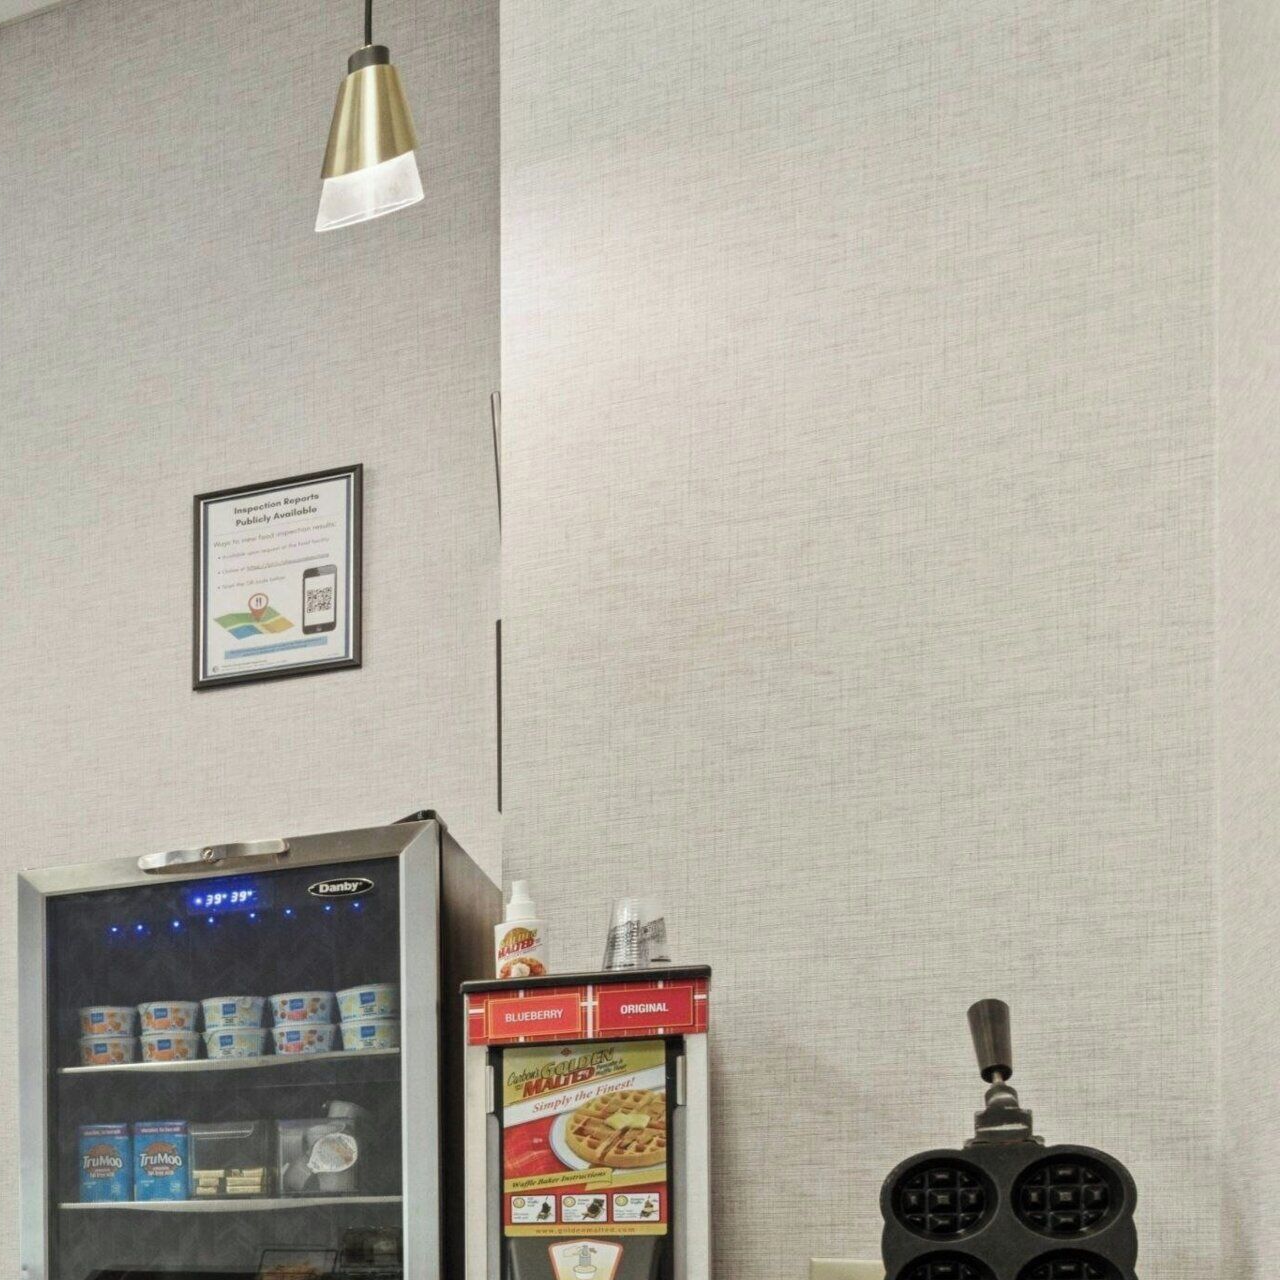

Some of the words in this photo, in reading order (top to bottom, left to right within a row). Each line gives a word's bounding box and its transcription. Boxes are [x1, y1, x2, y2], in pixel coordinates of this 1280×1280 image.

[234, 498, 282, 514] Inspection
[283, 493, 320, 507] Reports
[235, 514, 272, 527] Publicly
[273, 506, 318, 520] Available
[318, 882, 359, 894] Danby
[505, 1009, 563, 1022] BLUEBERRY
[620, 1002, 669, 1015] ORIGINAL
[541, 1047, 615, 1077] GOLDEN
[522, 1066, 596, 1098] MALTED
[532, 1097, 573, 1114] Simply
[575, 1088, 593, 1101] the
[596, 1077, 636, 1096] Finest!
[83, 1155, 123, 1169] TruMoo
[140, 1153, 182, 1167] TruMoo
[512, 1179, 538, 1188] Waffle
[562, 1170, 606, 1182] Instructions
